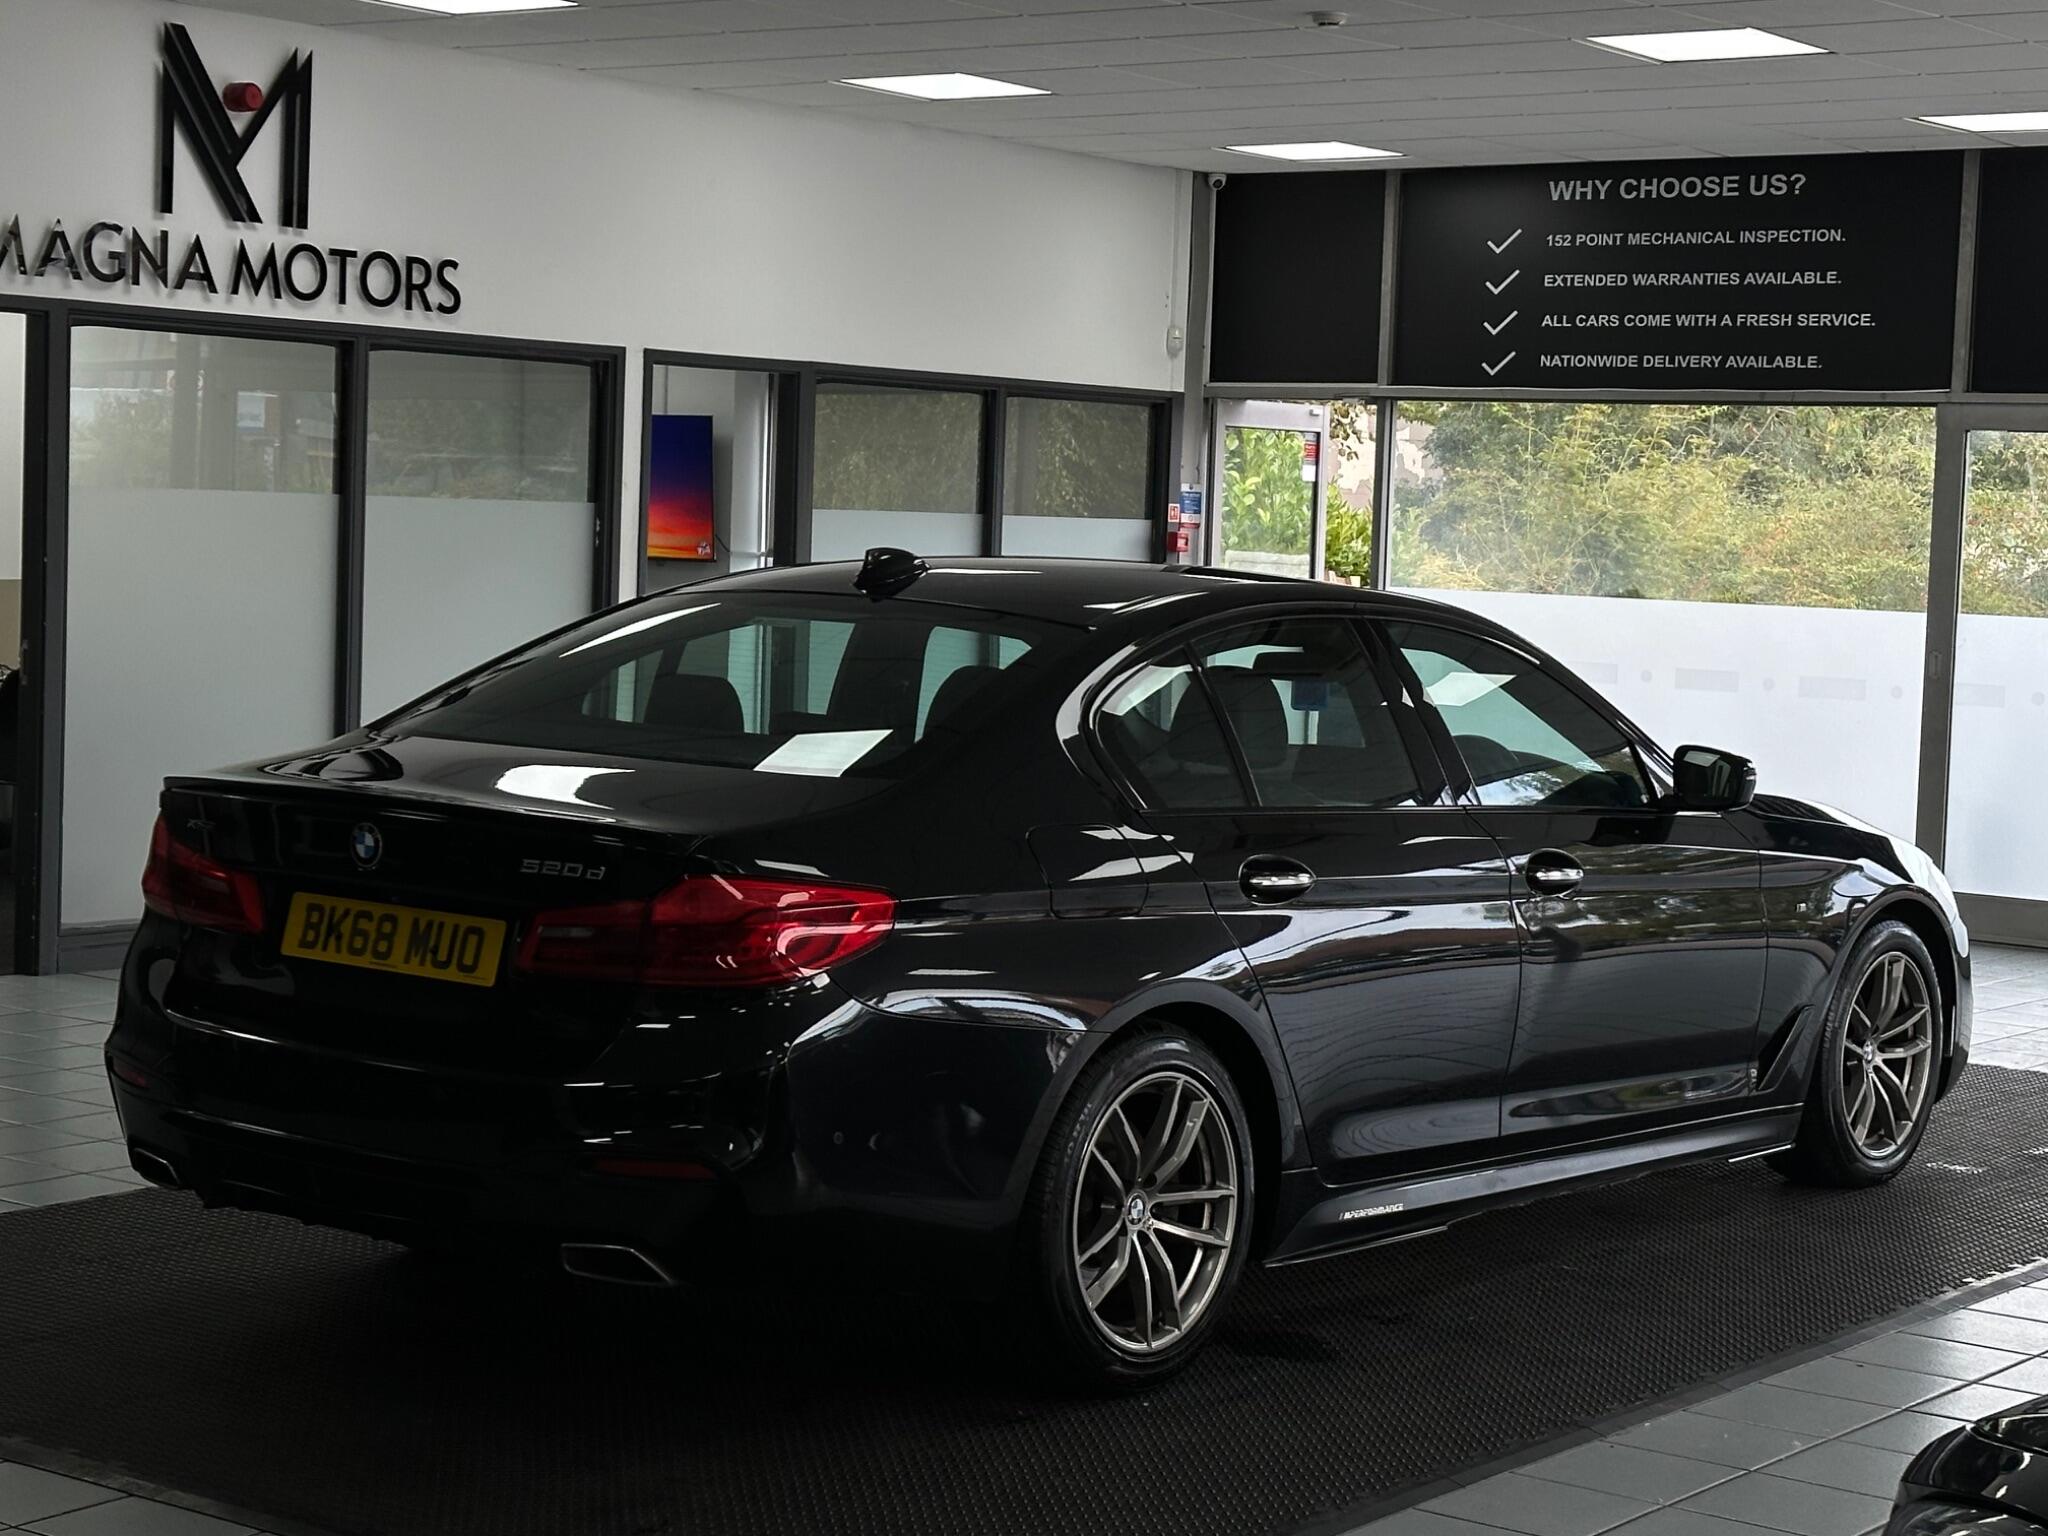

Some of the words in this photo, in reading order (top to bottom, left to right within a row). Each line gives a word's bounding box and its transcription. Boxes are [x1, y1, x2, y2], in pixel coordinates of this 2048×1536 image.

[1549, 179, 1613, 201] WHY
[1619, 176, 1740, 199] CHOOSE
[1750, 173, 1806, 196] US?
[1546, 234, 1572, 247] 152
[1576, 233, 1624, 246] POINT
[1628, 230, 1736, 245] MECHANICAL
[1739, 228, 1847, 243] INSPECTION.
[230, 238, 462, 315] MOTORS
[1544, 274, 1628, 287] EXTENDED
[1632, 272, 1740, 286] WARRANTIES
[1743, 271, 1842, 285] AVAILABLE.
[1541, 315, 1572, 327] ALL
[1575, 314, 1620, 327] CARS
[1624, 314, 1672, 327] COME
[1675, 314, 1717, 327] WITH
[1720, 314, 1733, 327] A
[1736, 314, 1792, 327] FRESH
[1797, 313, 1876, 327] SERVICE.
[1540, 354, 1638, 368] NATIONWIDE
[1643, 355, 1722, 368] DELIVERY
[1725, 355, 1823, 369] AVAILABLE.
[520, 858, 606, 880] 520d
[297, 902, 398, 961] BK68
